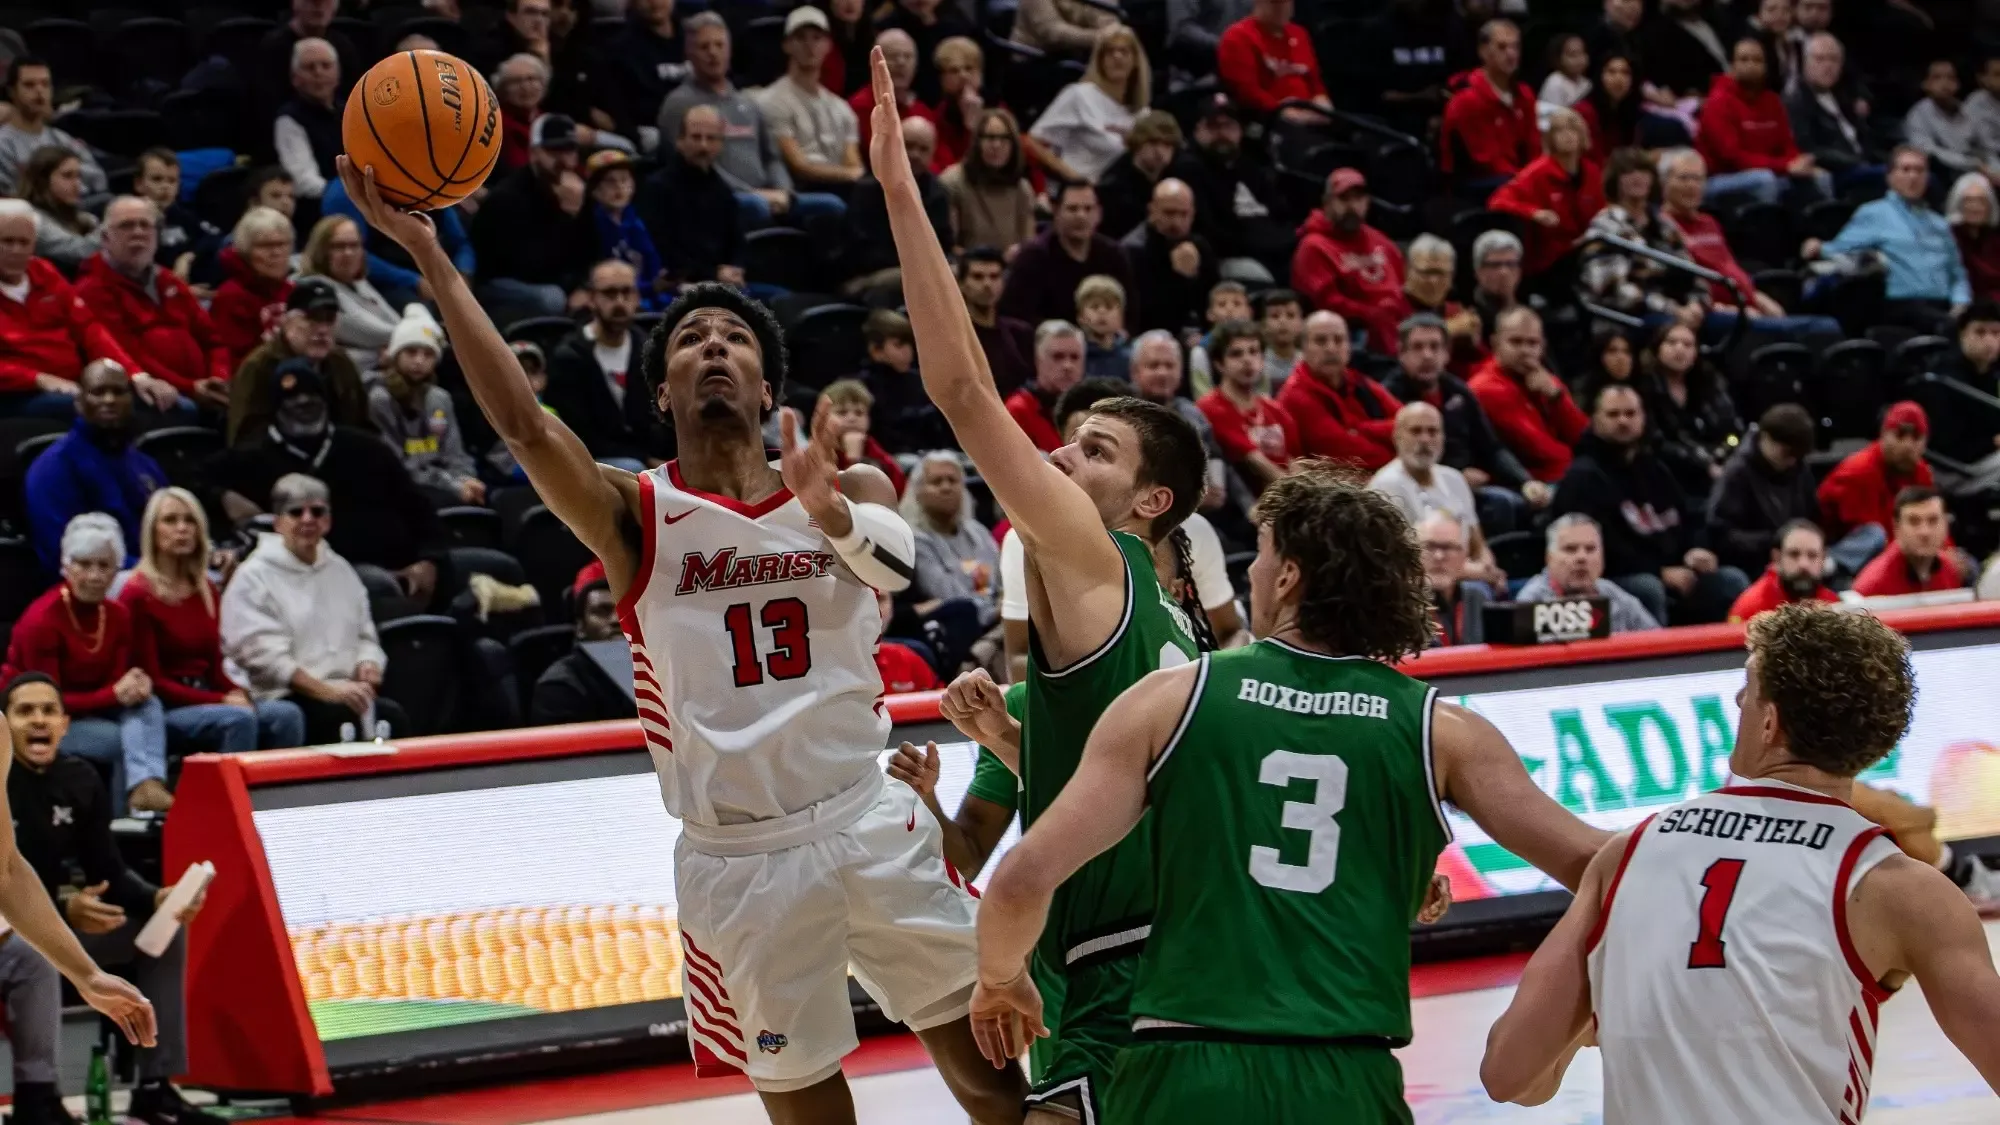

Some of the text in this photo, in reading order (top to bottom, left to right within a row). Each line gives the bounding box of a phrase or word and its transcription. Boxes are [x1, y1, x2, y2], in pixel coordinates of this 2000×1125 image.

[434, 58, 462, 110] EVO
[675, 547, 834, 596] MARIST
[724, 597, 812, 687] 13
[1533, 601, 1593, 633] POSS
[1237, 678, 1390, 720] ROXBURGH
[1550, 692, 1738, 814] ADA
[1248, 749, 1349, 894] 3
[1657, 807, 1836, 851] SCHOFIELD
[1687, 857, 1748, 970] 1
